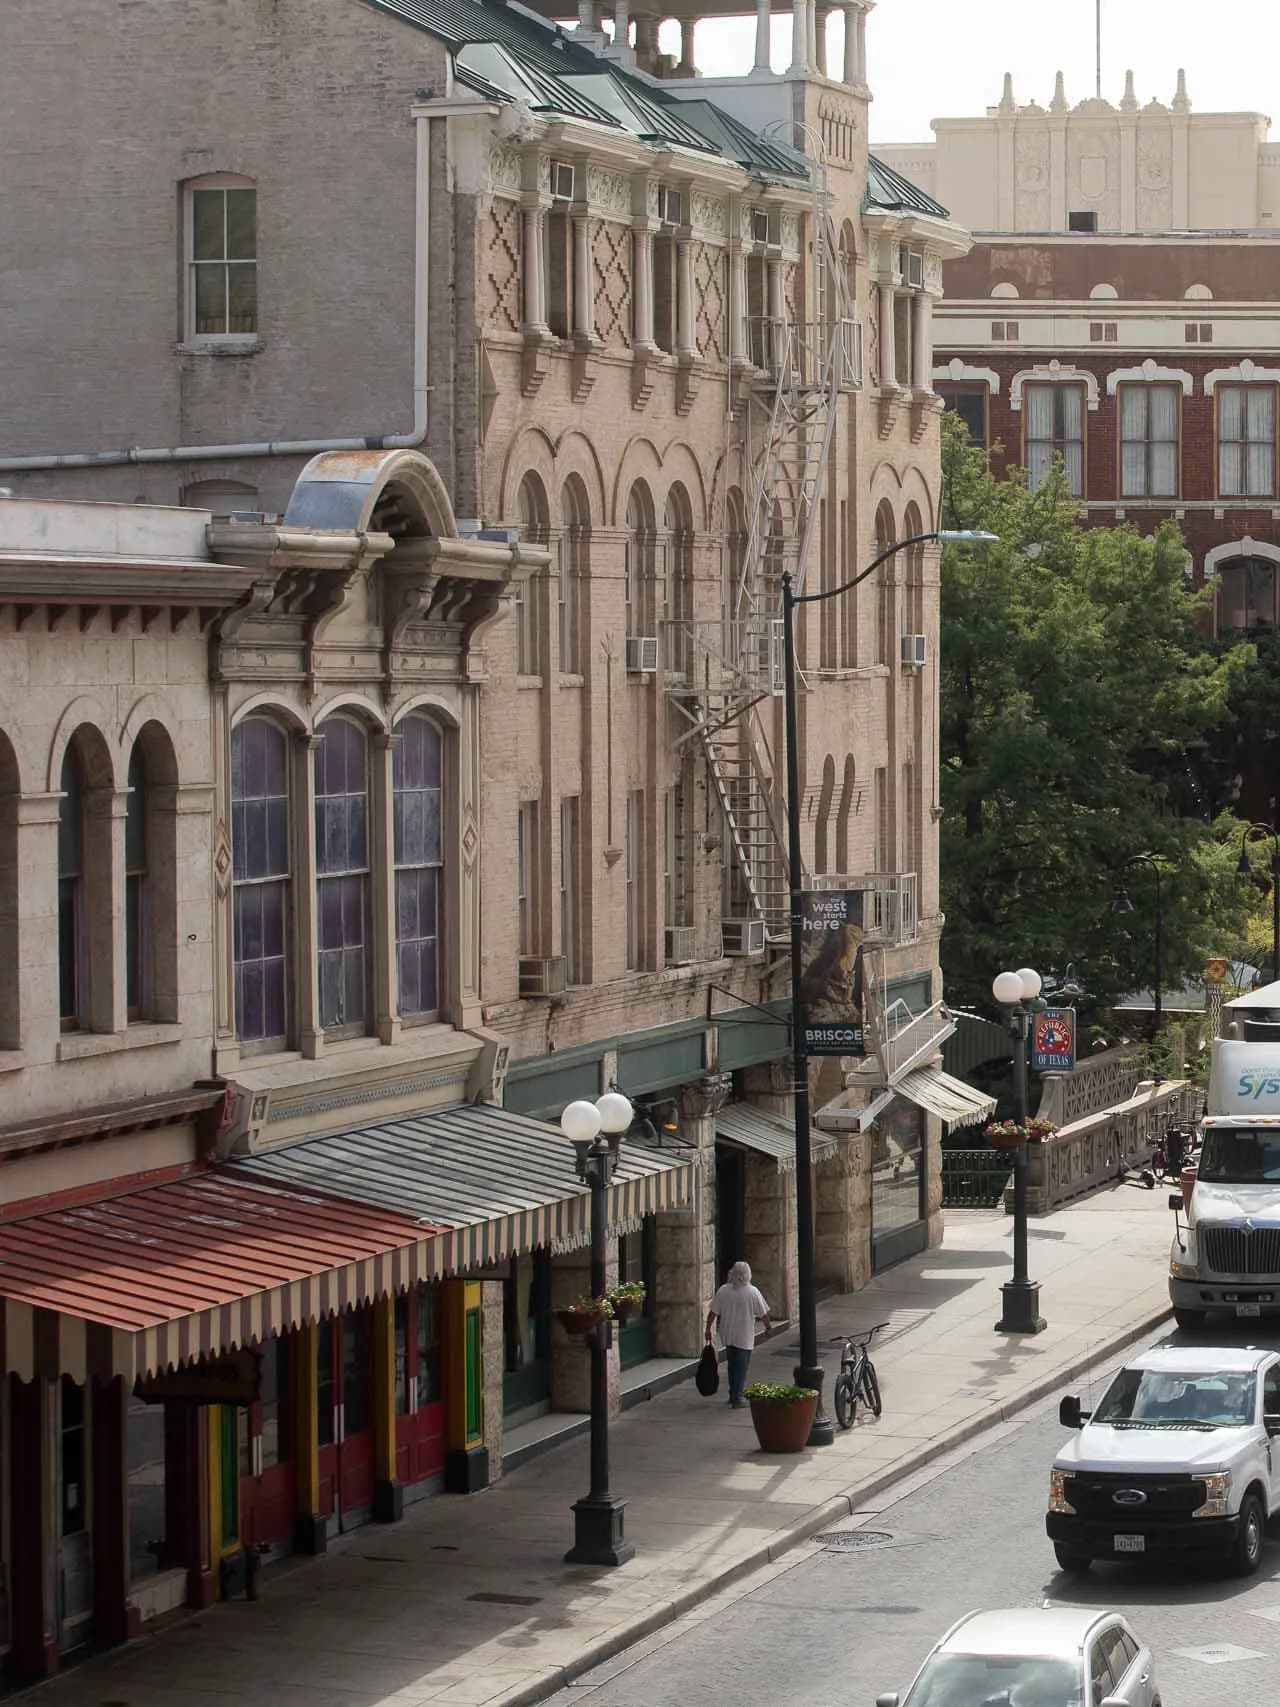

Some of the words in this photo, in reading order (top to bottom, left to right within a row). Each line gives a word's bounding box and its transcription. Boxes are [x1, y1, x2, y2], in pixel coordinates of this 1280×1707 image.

[812, 900, 847, 912] west
[803, 916, 840, 930] here
[1038, 1020, 1069, 1038] REPUBLIC
[805, 1030, 862, 1041] BRISCOE
[1038, 1055, 1046, 1065] OF
[1050, 1055, 1069, 1065] TEXAS
